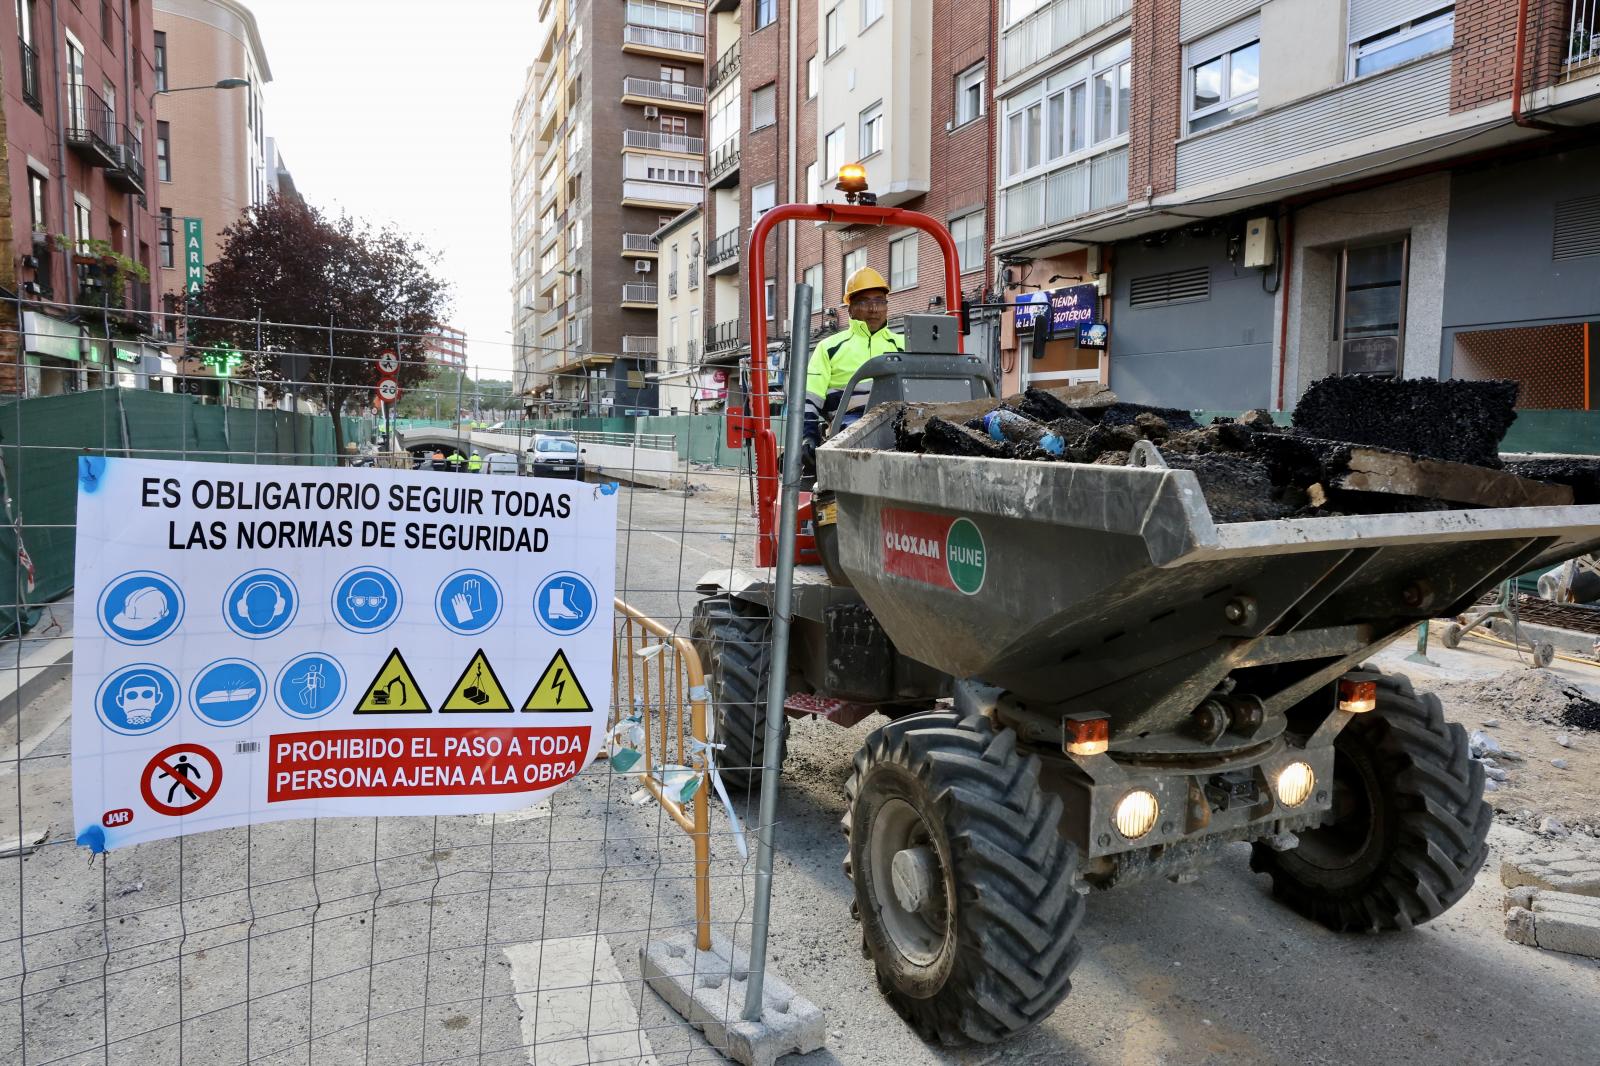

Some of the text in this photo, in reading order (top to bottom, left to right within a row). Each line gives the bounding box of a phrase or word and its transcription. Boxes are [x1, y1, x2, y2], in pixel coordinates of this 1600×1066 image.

[188, 221, 201, 307] FARMA
[1016, 306, 1023, 315] La
[1051, 294, 1078, 308] TIENDA
[1016, 319, 1022, 328] de
[1053, 307, 1092, 323] ESOTÉRICA
[141, 477, 571, 519] ES OBLIGATORIO SEGUIR TODAS
[168, 520, 549, 553] LAS NORMAS DE SEGURIDAD
[949, 544, 983, 568] HUNE
[276, 737, 404, 764] PROHIBIDO
[411, 737, 438, 758] EL
[444, 736, 503, 758] PASO
[507, 736, 523, 757] A
[527, 735, 582, 756] TODA
[276, 760, 576, 793] PERSONA AJENA A LA OBRA
[105, 811, 129, 825] JAR
